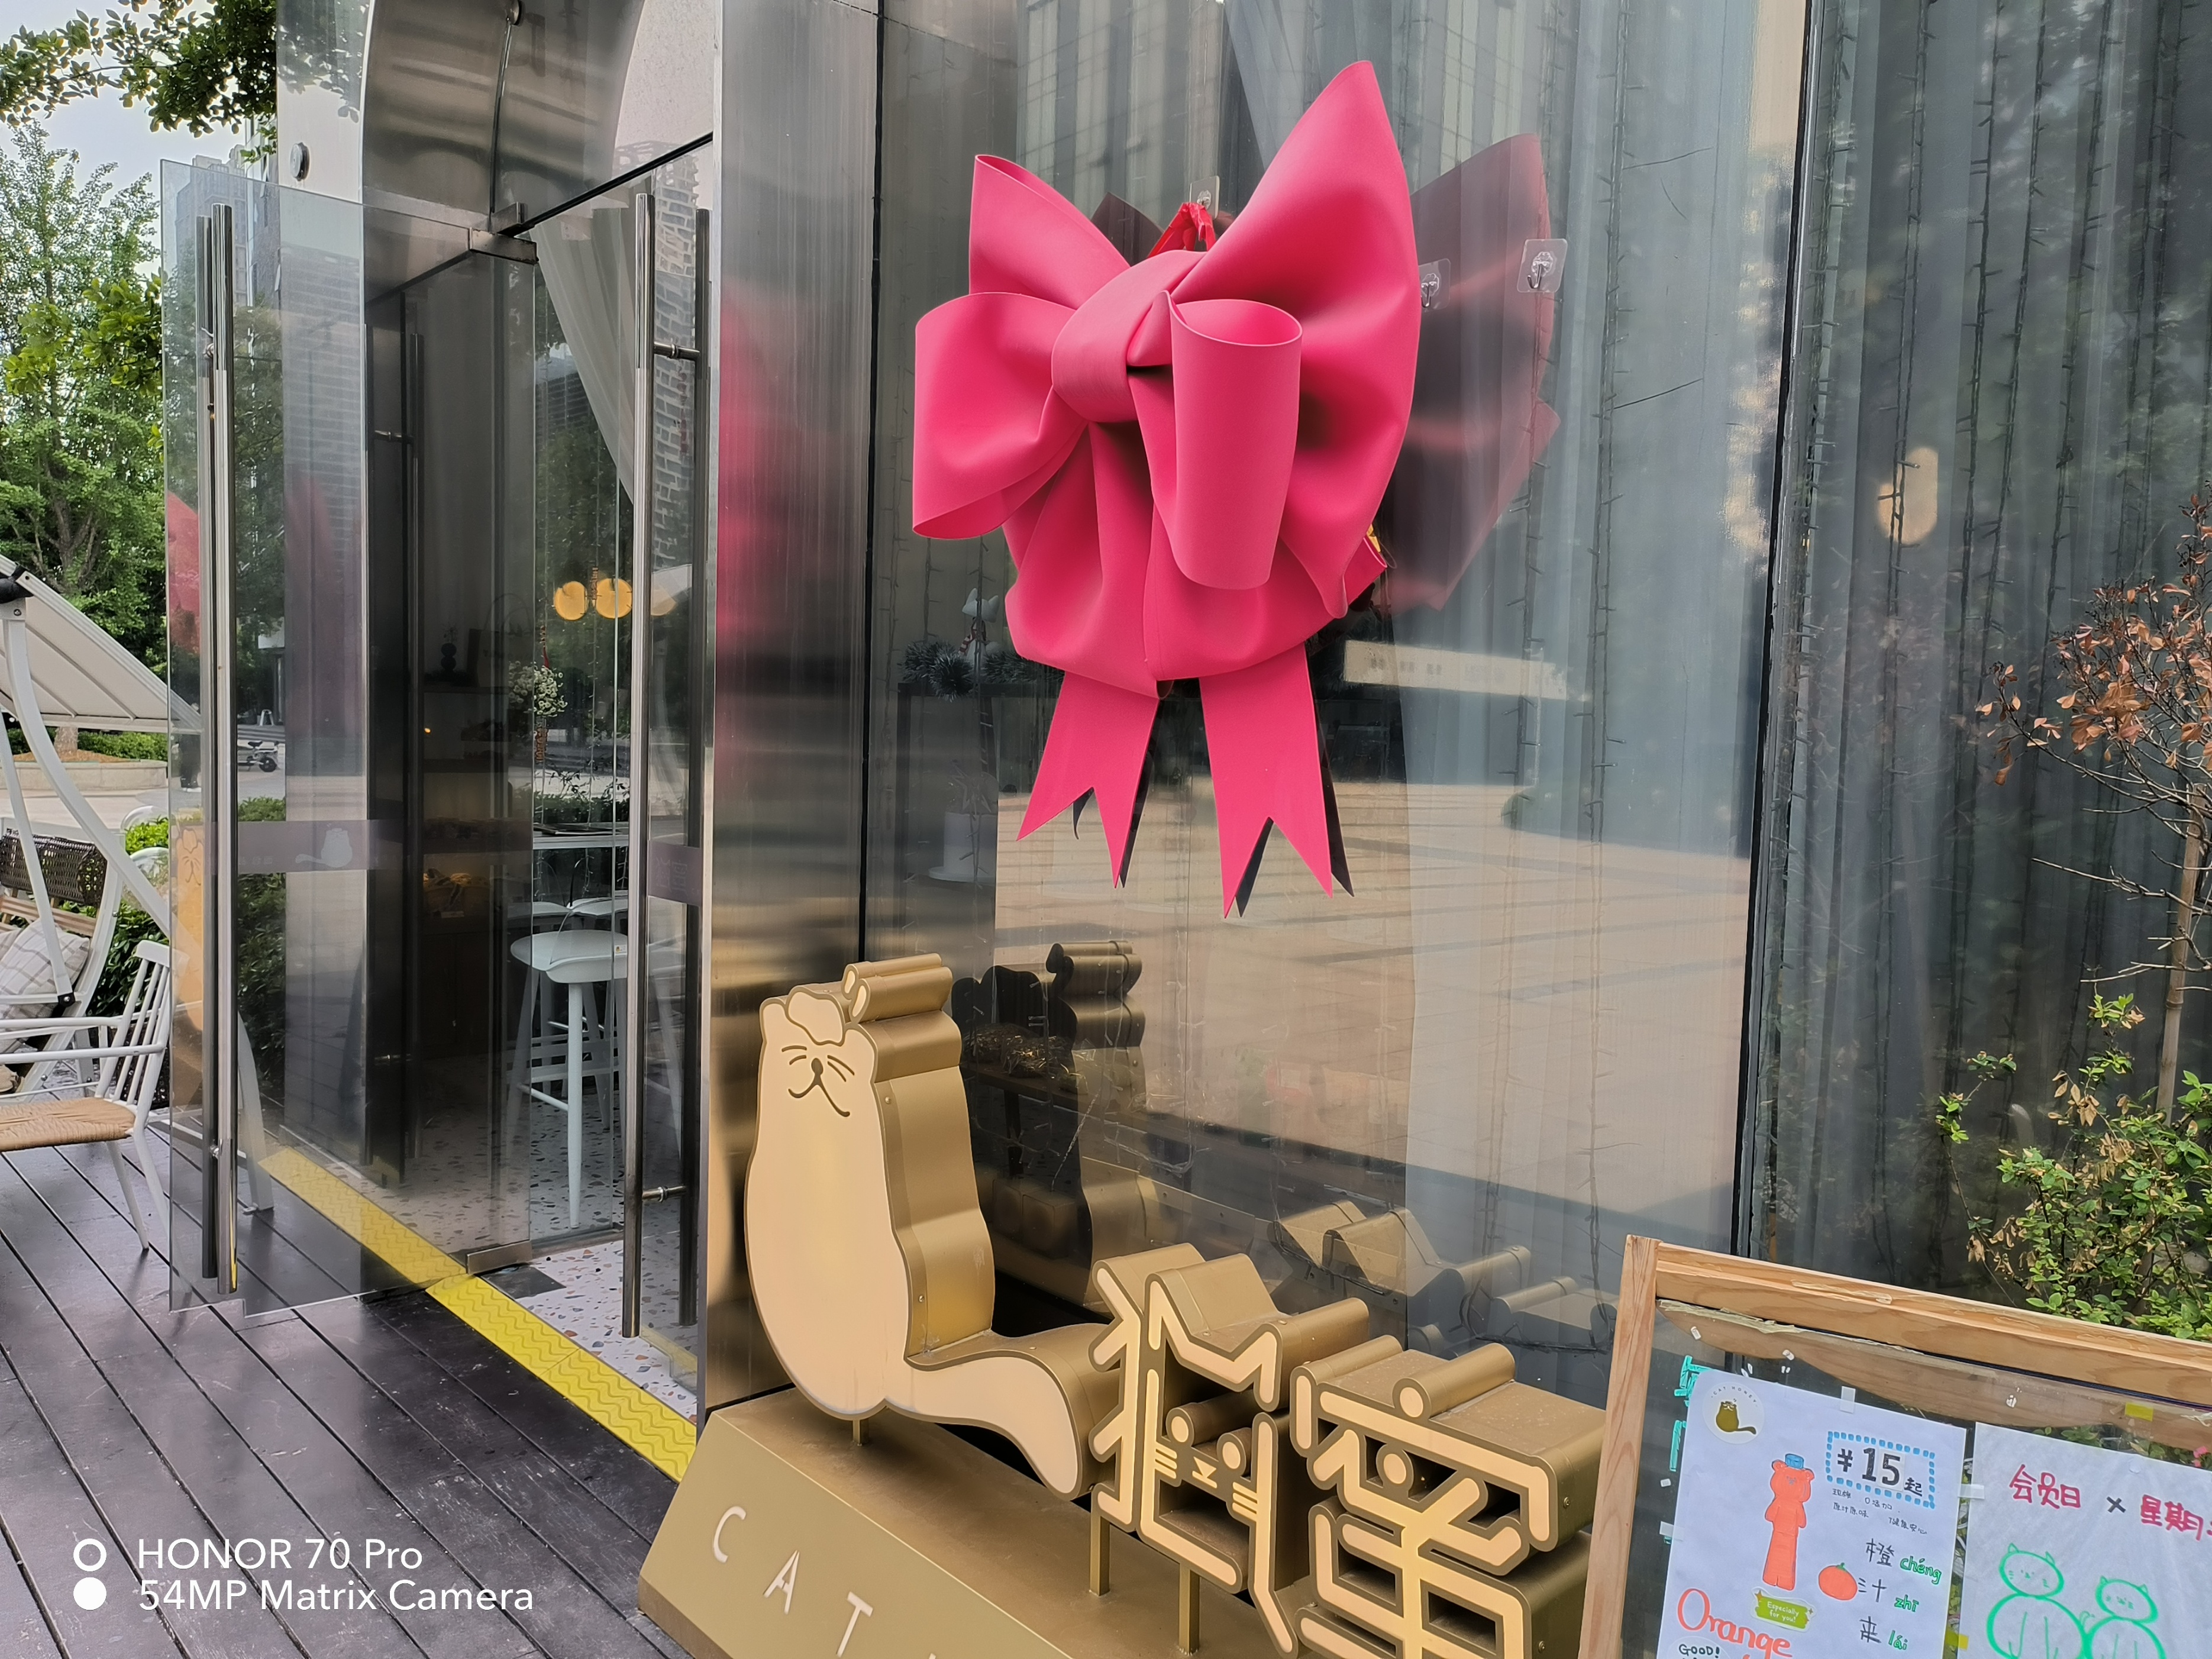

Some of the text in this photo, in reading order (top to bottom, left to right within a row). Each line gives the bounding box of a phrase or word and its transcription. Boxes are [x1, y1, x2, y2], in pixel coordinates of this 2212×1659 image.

[1713, 1386, 1756, 1403] CAT HONEY
[2140, 1494, 2212, 1541] 星期
[1866, 1538, 1895, 1567] 橙
[712, 1506, 874, 1657] CAT
[1767, 1601, 1799, 1616] Especially
[1769, 1609, 1797, 1623] for you!
[1677, 1588, 1793, 1659] Orange
[1678, 1644, 1720, 1659] GOOD!
